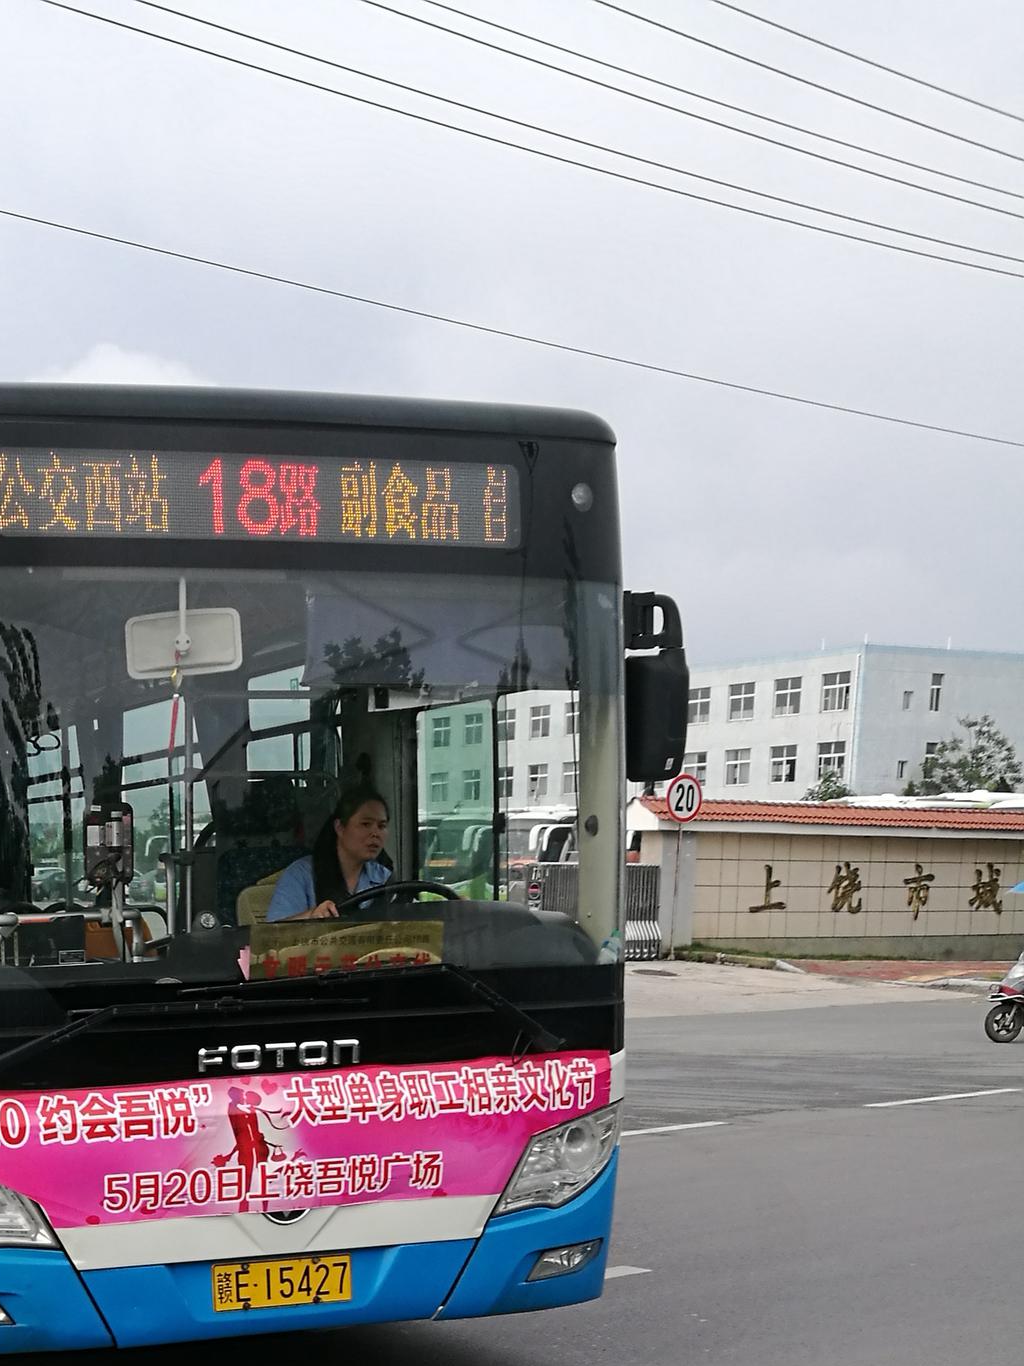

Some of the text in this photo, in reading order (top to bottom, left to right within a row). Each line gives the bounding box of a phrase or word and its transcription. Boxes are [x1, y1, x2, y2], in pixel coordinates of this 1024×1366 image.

[198, 457, 320, 537] 18路
[340, 459, 459, 541] 副食品
[675, 784, 695, 812] 20
[749, 861, 1003, 920] 上饶市城
[198, 1037, 360, 1073] FOTON
[284, 1057, 597, 1126] 大型单身职工相亲文化节
[103, 1151, 443, 1213] 5月20日上饶吾悦广场
